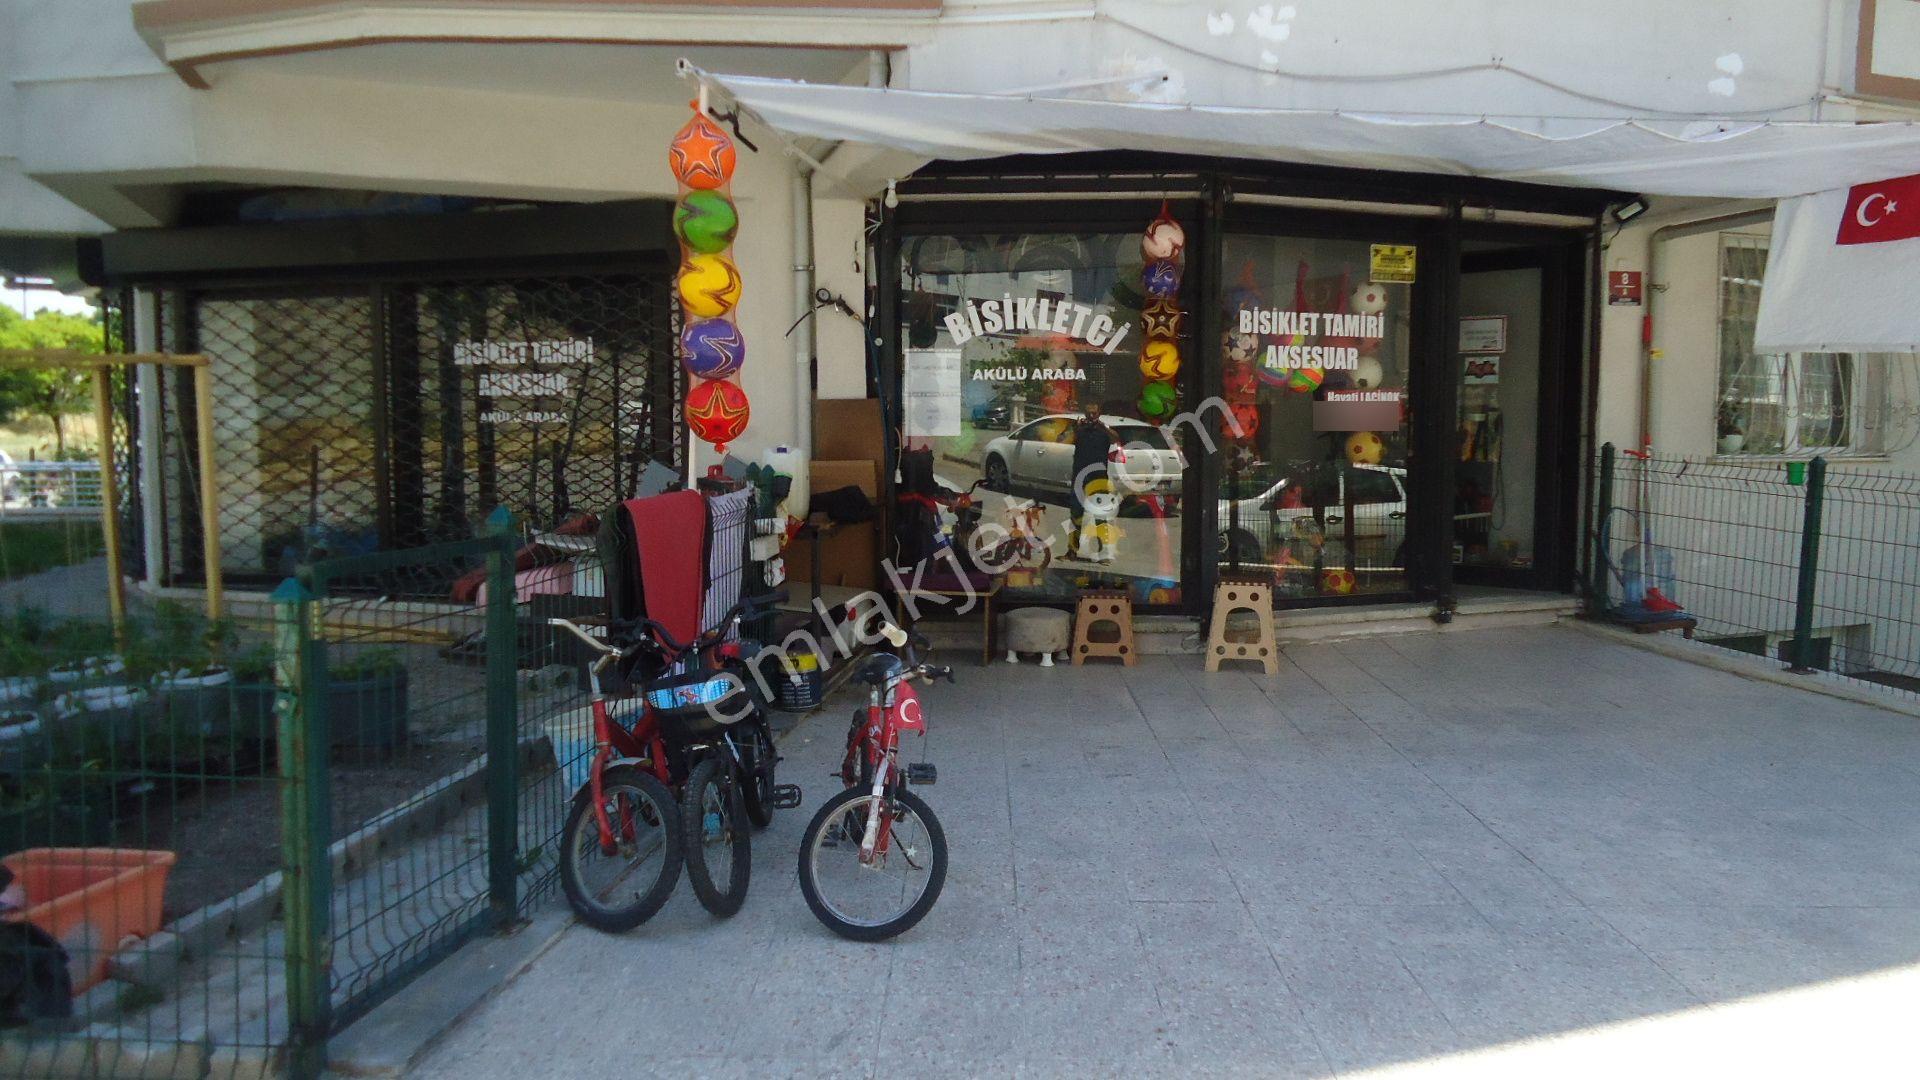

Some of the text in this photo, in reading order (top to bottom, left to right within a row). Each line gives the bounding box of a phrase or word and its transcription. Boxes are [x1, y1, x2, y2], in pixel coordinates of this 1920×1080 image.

[1621, 272, 1629, 285] 8
[1239, 306, 1385, 338] BİSİKLET TAMİRİ
[1264, 345, 1359, 371] AKSESUAR
[972, 366, 1028, 381] AKÜLÜ
[1031, 368, 1087, 381] ARABA
